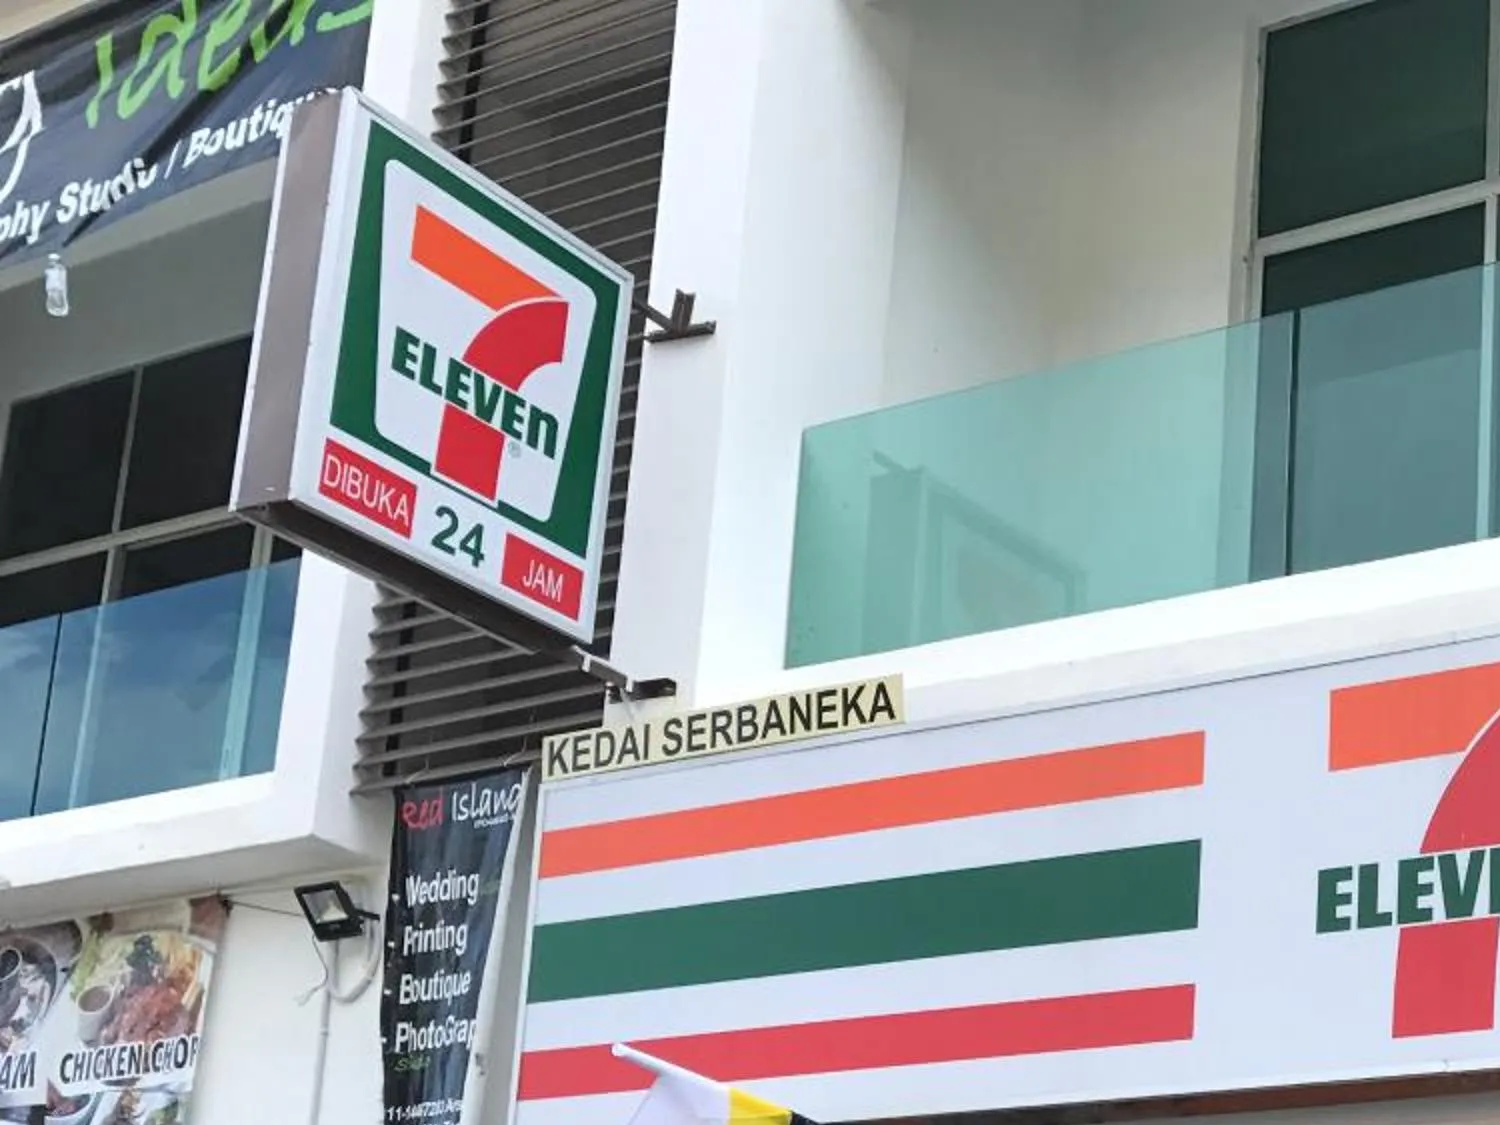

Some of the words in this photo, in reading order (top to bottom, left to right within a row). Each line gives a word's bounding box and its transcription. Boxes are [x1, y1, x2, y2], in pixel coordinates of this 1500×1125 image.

[183, 88, 340, 169] Boutiq
[409, 204, 569, 501] 7
[323, 453, 411, 527] DIBUKA
[430, 505, 486, 568] 24
[521, 559, 565, 603] JAM
[547, 723, 651, 777] KEDAI
[660, 680, 897, 757] SERBANEKA
[405, 870, 481, 908] Wedding
[398, 967, 472, 1008] Boutique
